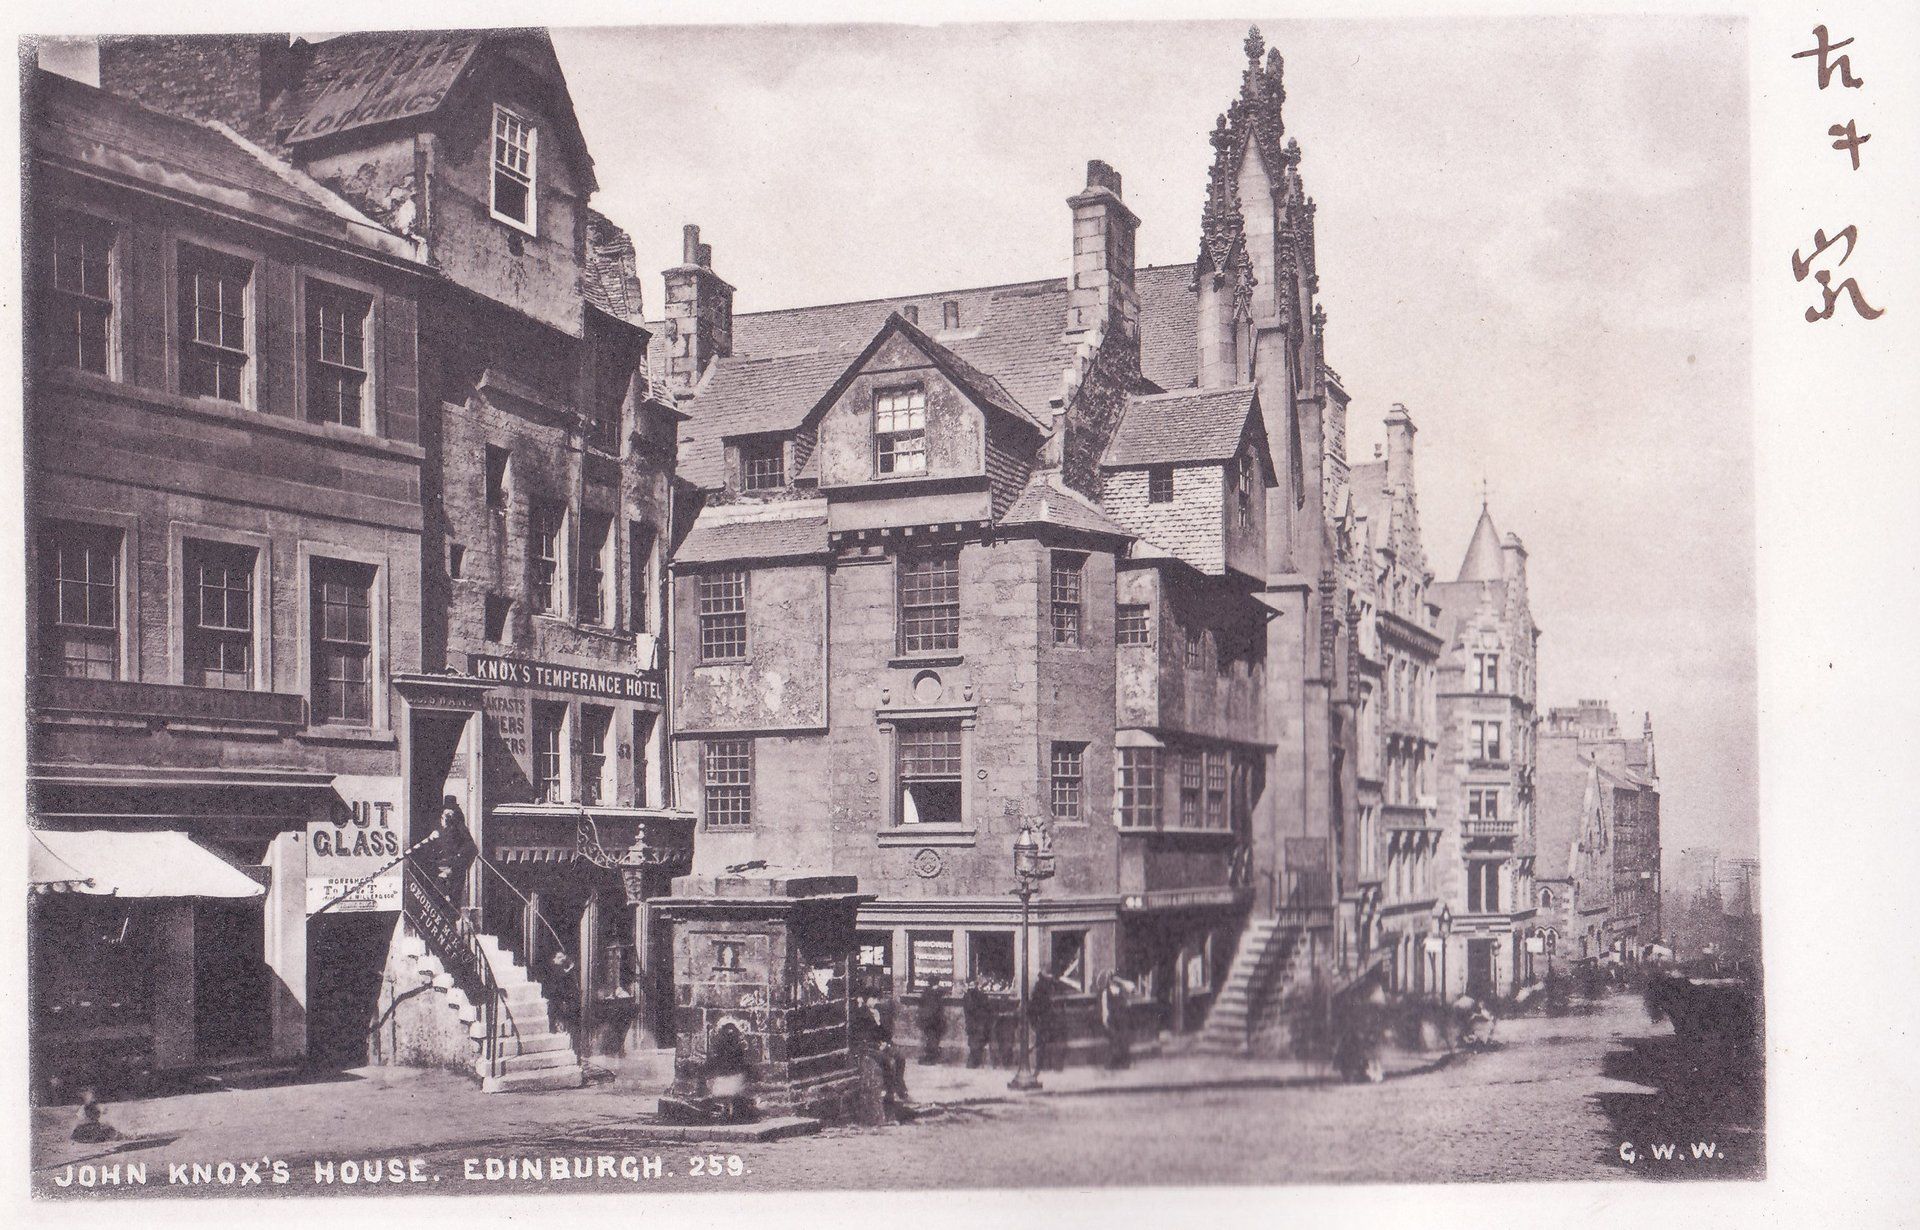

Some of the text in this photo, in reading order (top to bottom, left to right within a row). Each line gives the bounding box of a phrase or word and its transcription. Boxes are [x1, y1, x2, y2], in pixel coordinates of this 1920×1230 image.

[477, 658, 662, 701] KNOX'S TEMPERANCE HOTEL
[312, 830, 399, 857] GLASS
[409, 882, 442, 925] GEORGE
